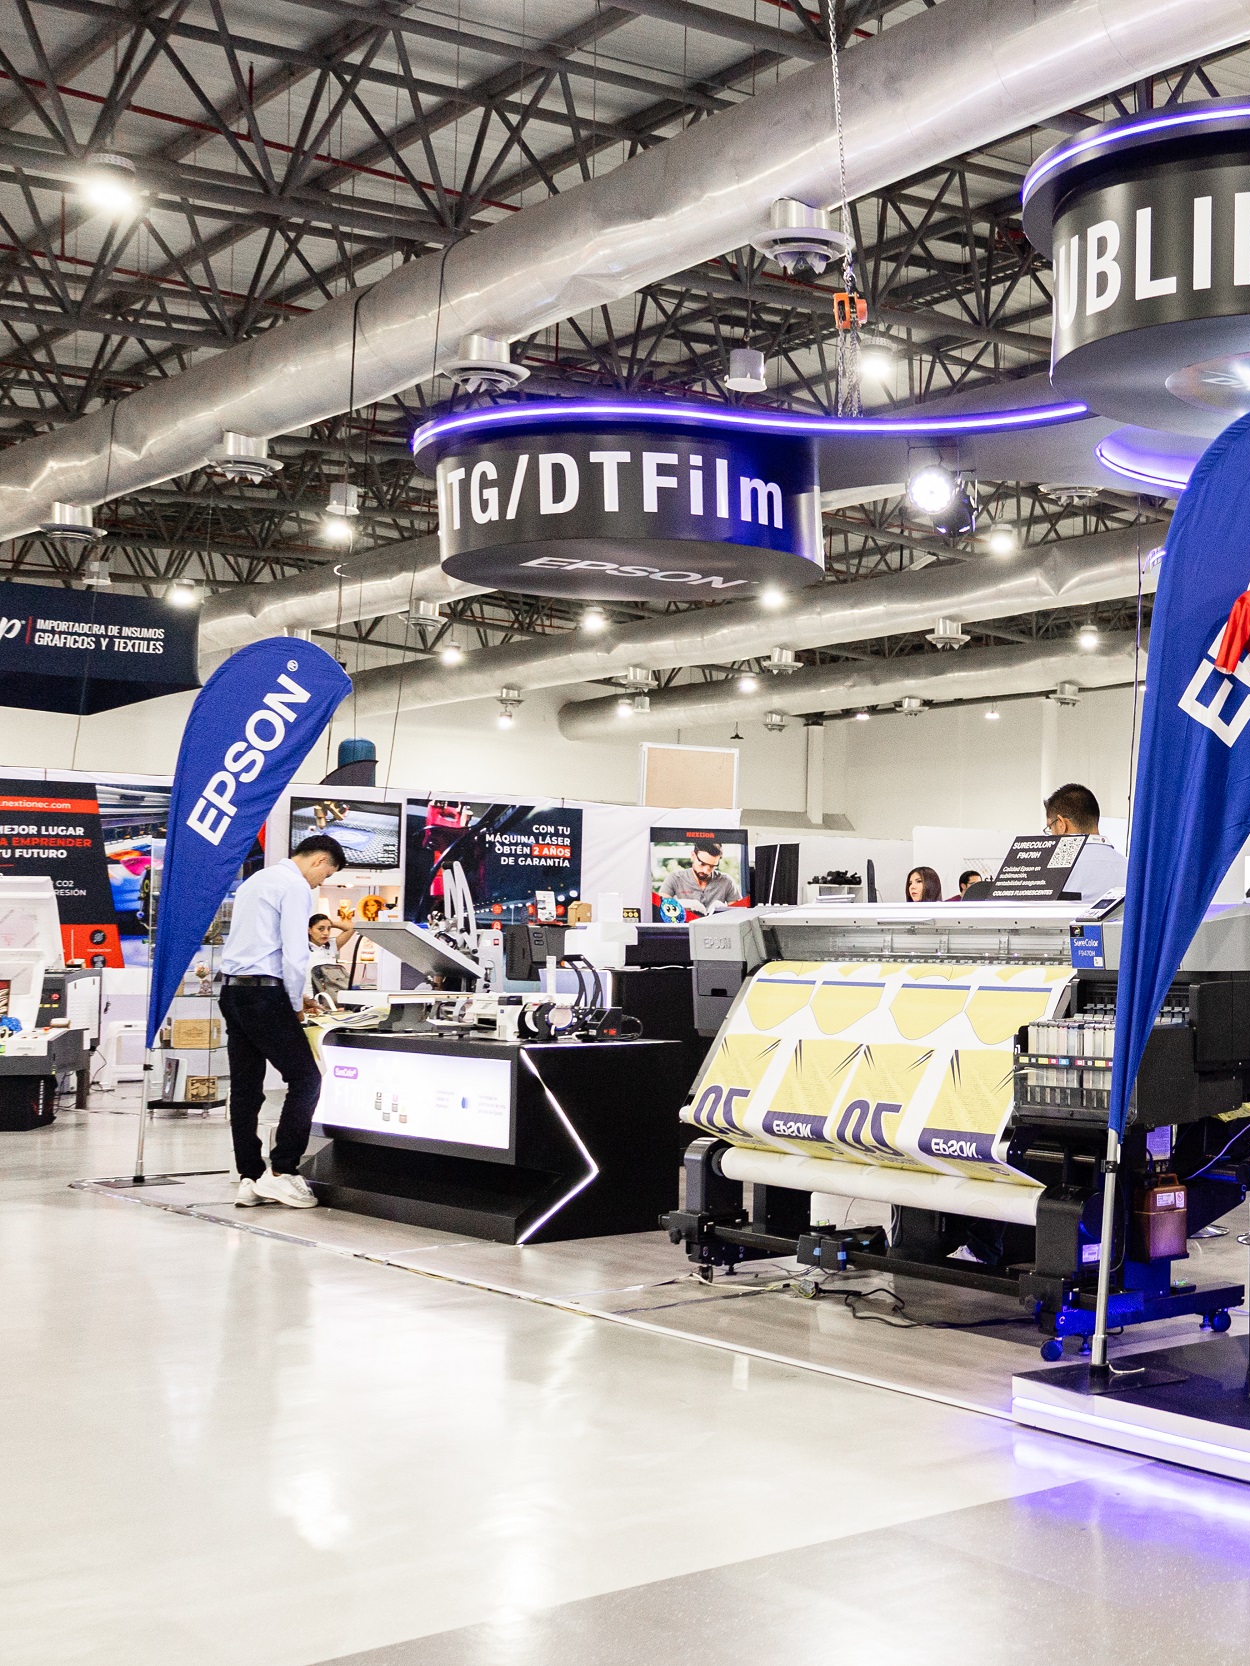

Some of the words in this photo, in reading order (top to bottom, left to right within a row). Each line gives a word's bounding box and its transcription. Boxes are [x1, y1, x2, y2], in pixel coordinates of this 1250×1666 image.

[36, 619, 106, 635] IMPORTADORA
[108, 625, 120, 636] DE
[122, 627, 165, 639] INSUMOS
[34, 631, 96, 649] GRÁFICOS
[100, 638, 109, 650] Y
[113, 638, 164, 654] TEXTILES
[41, 826, 84, 836] LUGAR
[532, 825, 555, 833] CON
[557, 826, 571, 835] TU
[12, 837, 92, 847] EMPRENDER
[485, 833, 536, 844] MÁQUINA
[539, 835, 571, 846] LÁSER
[15, 849, 67, 859] FUTURO
[495, 844, 530, 855] OBTÉN
[533, 847, 540, 855] 2
[543, 846, 571, 857] AÑOS
[501, 857, 515, 865] DE
[518, 857, 570, 867] GARANTÍA
[1073, 938, 1098, 947] SureColor
